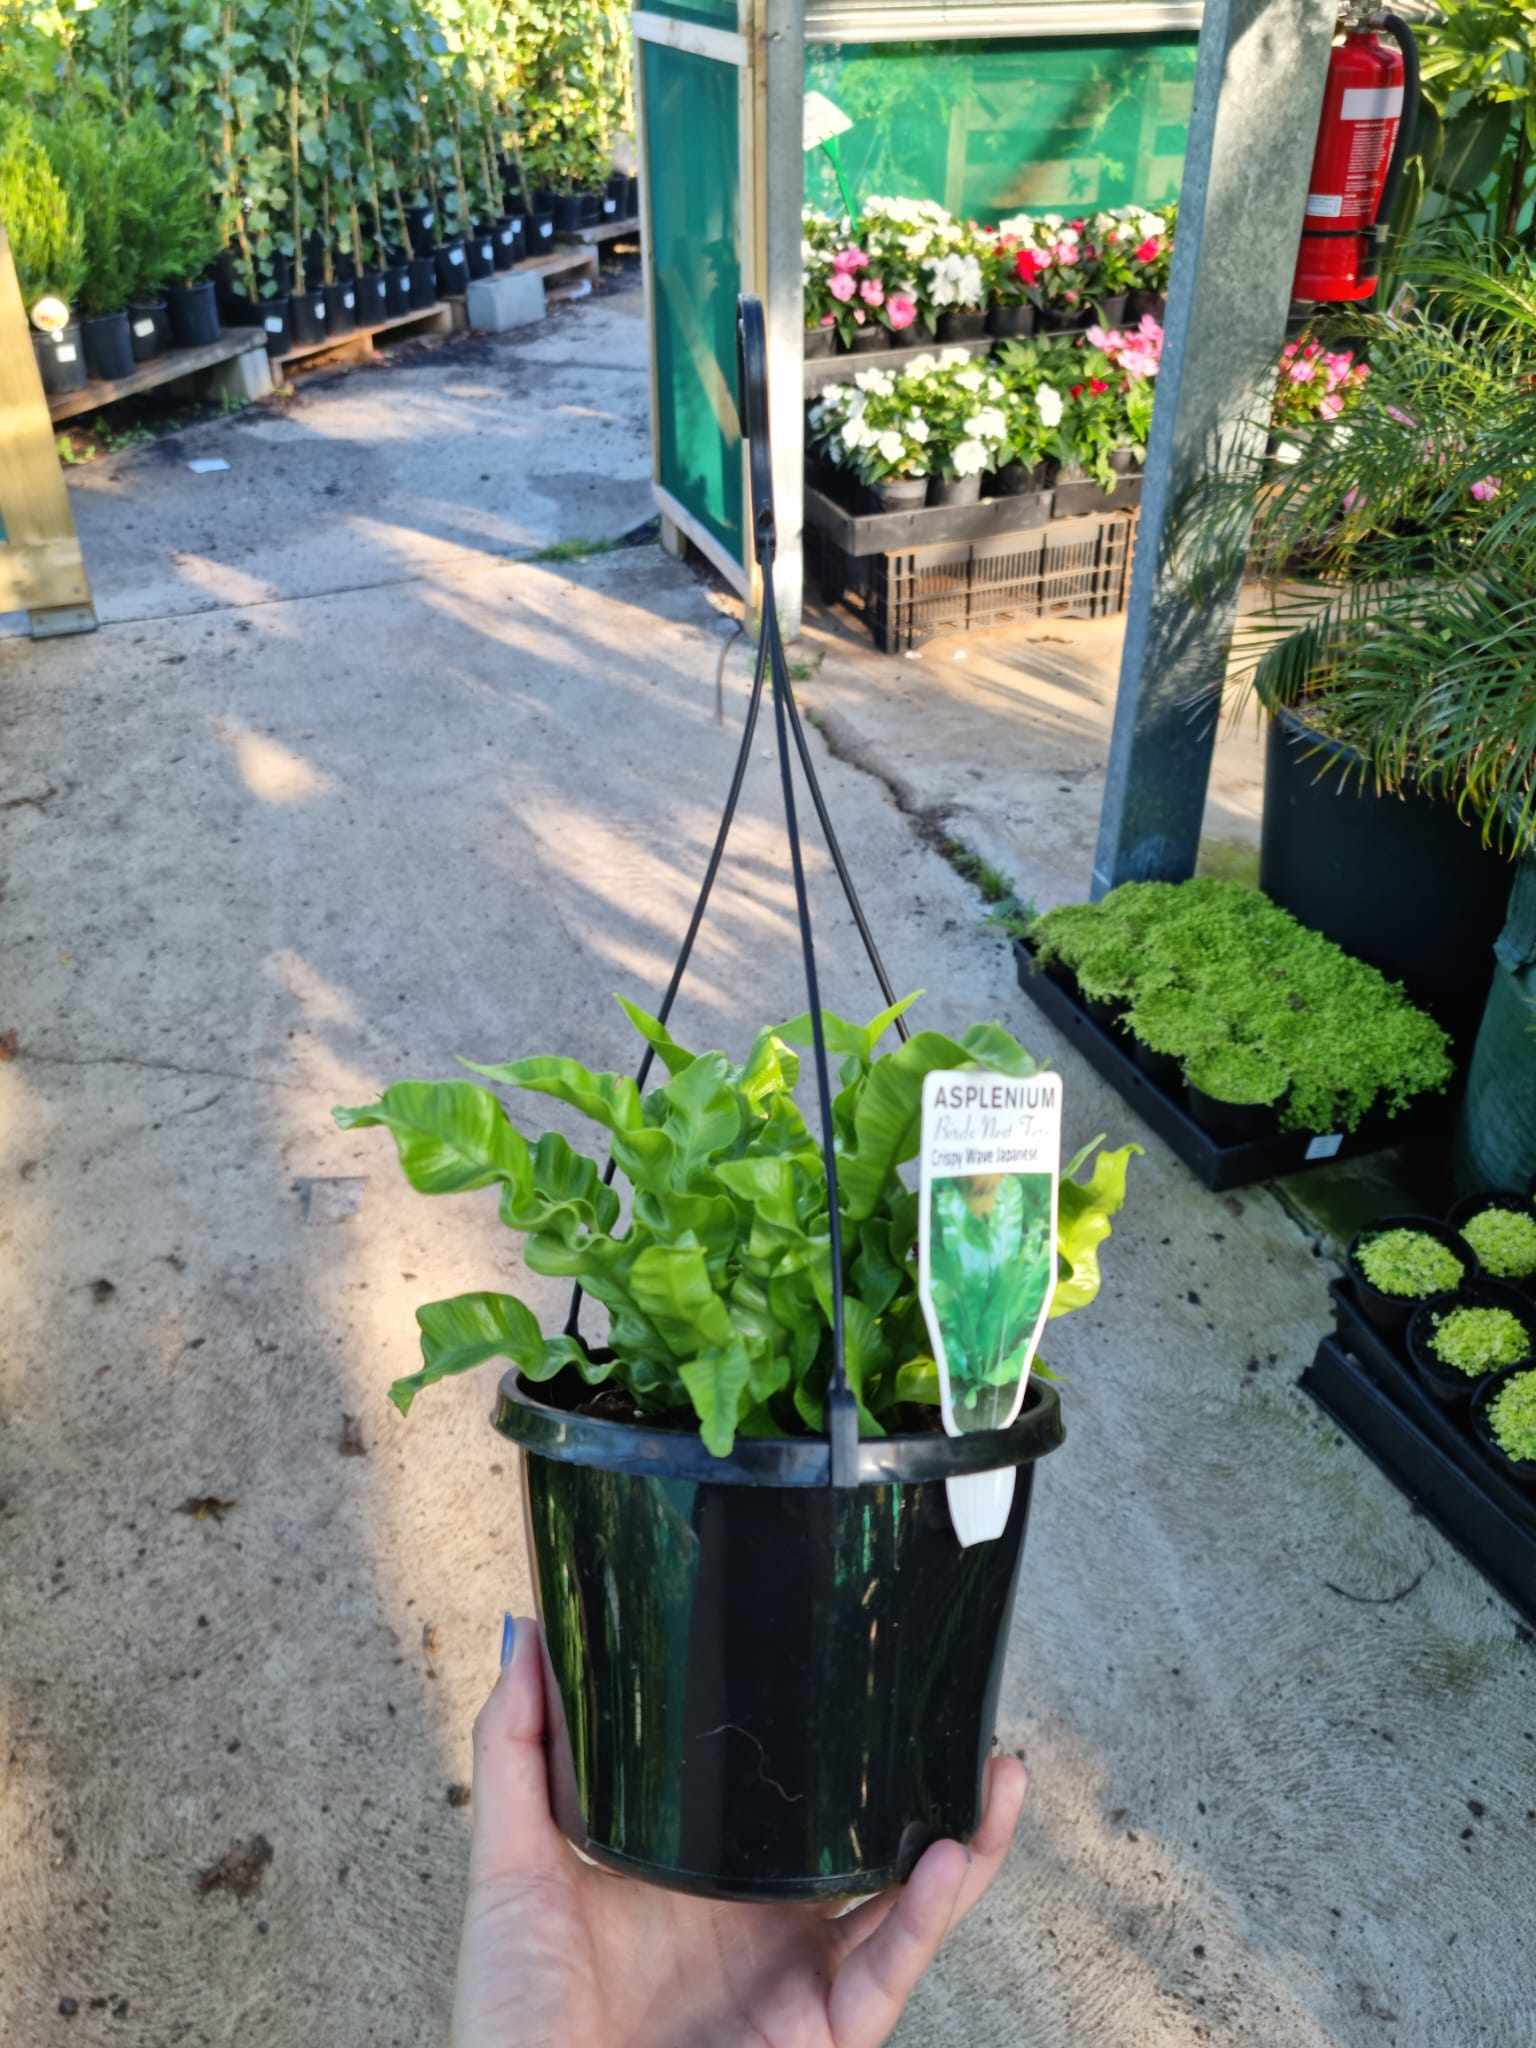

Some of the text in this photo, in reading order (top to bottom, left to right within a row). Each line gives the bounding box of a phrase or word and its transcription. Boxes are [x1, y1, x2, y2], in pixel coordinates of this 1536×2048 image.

[934, 1086, 1055, 1109] ASPLENIUM
[931, 1148, 962, 1169] Crispy
[964, 1147, 993, 1165] Wave
